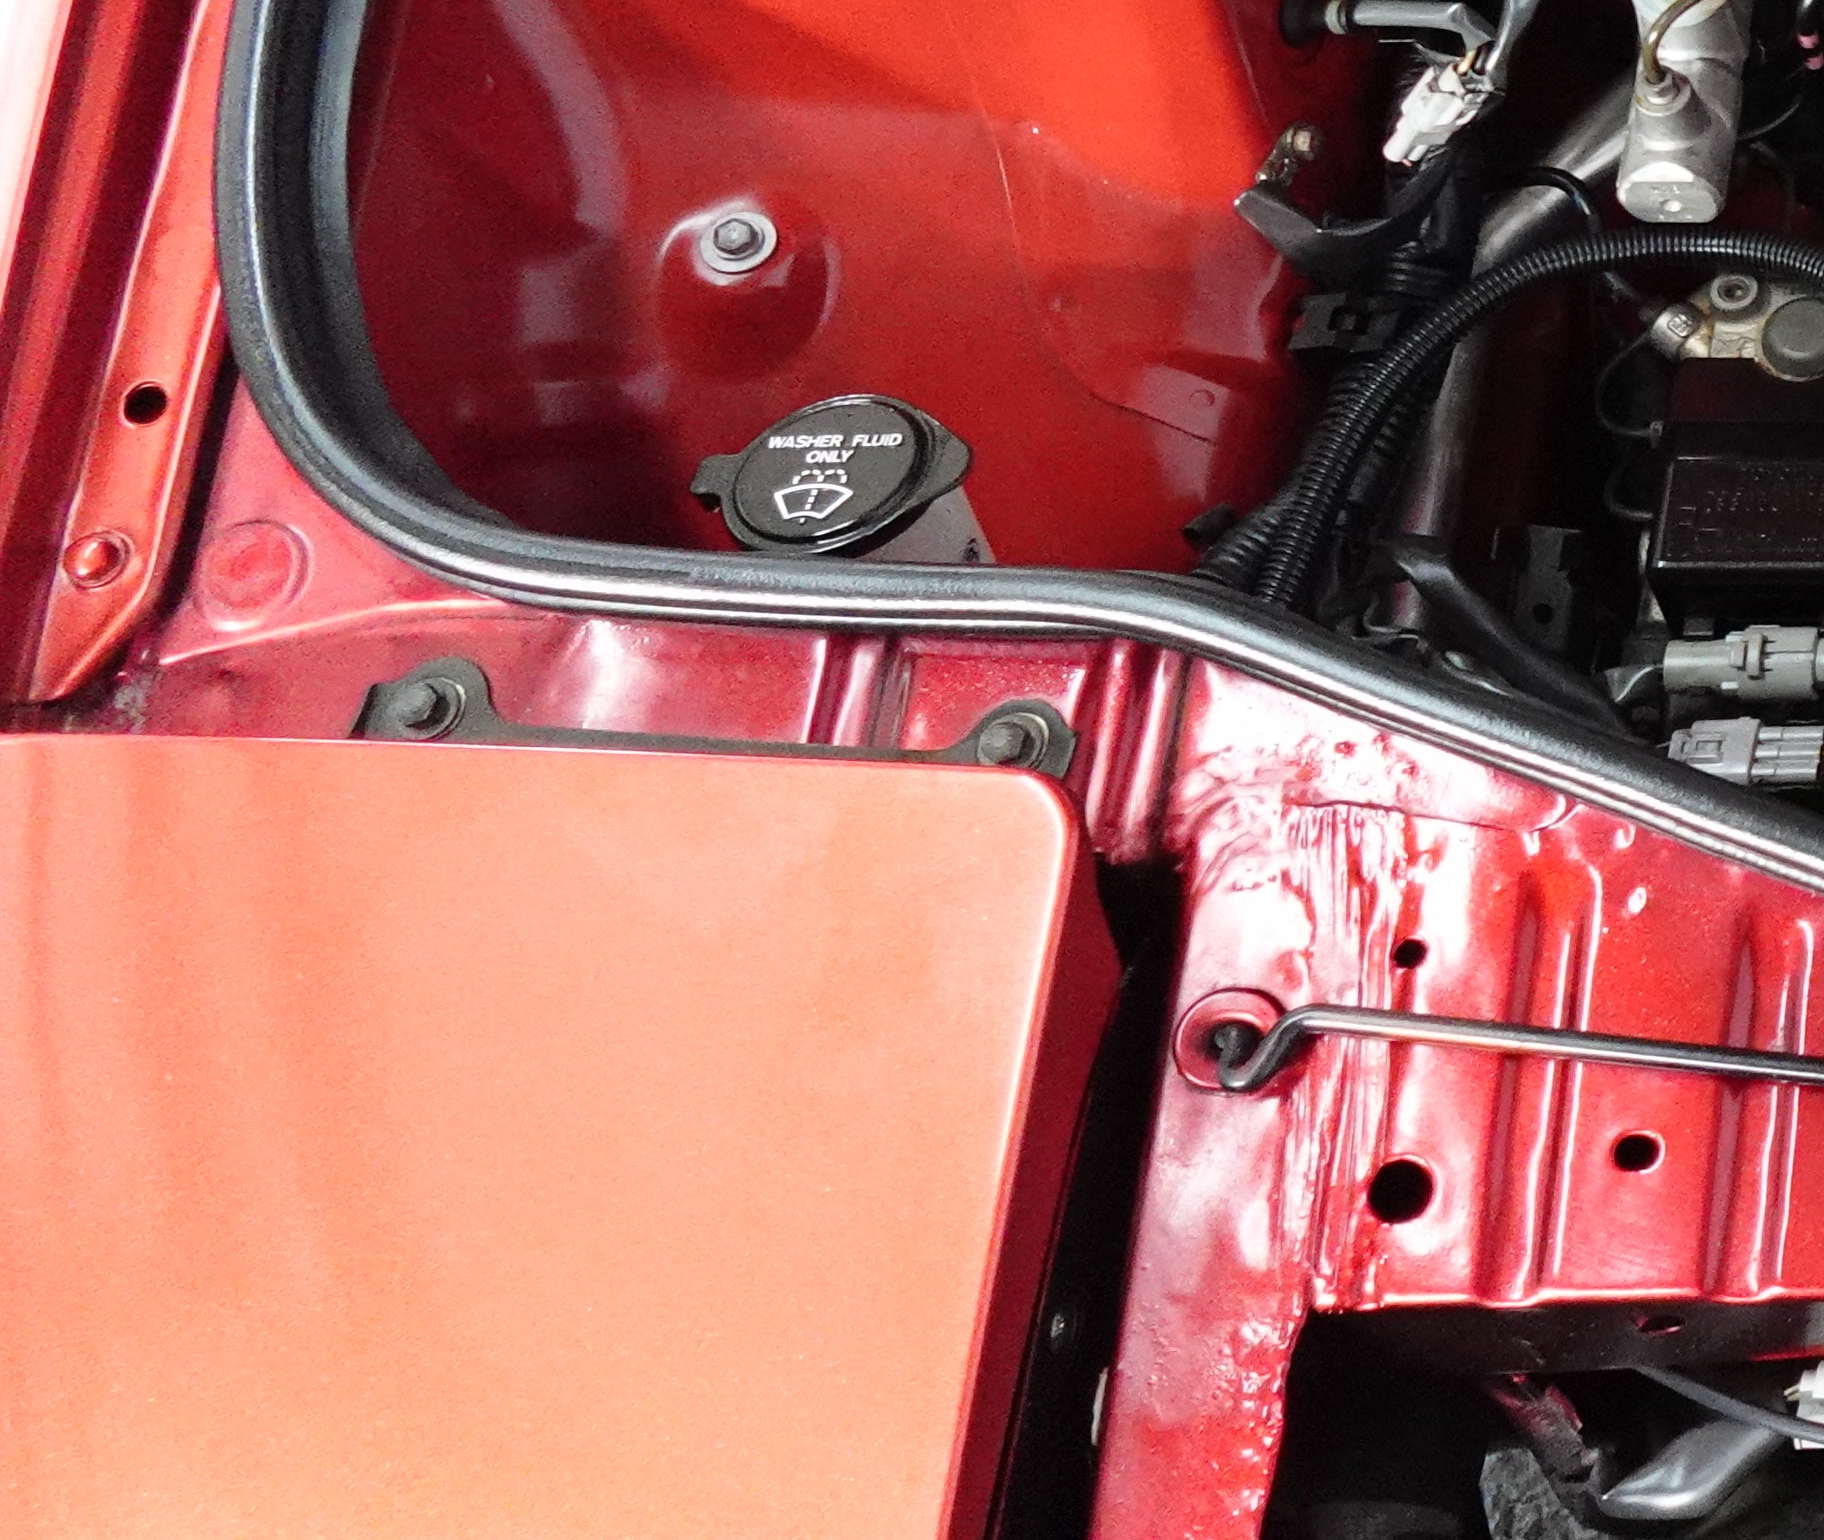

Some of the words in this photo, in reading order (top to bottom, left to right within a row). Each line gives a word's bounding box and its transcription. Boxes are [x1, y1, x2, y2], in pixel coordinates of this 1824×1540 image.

[768, 434, 843, 450] WASHER
[851, 433, 902, 448] FLUID
[805, 450, 854, 464] ONLY
